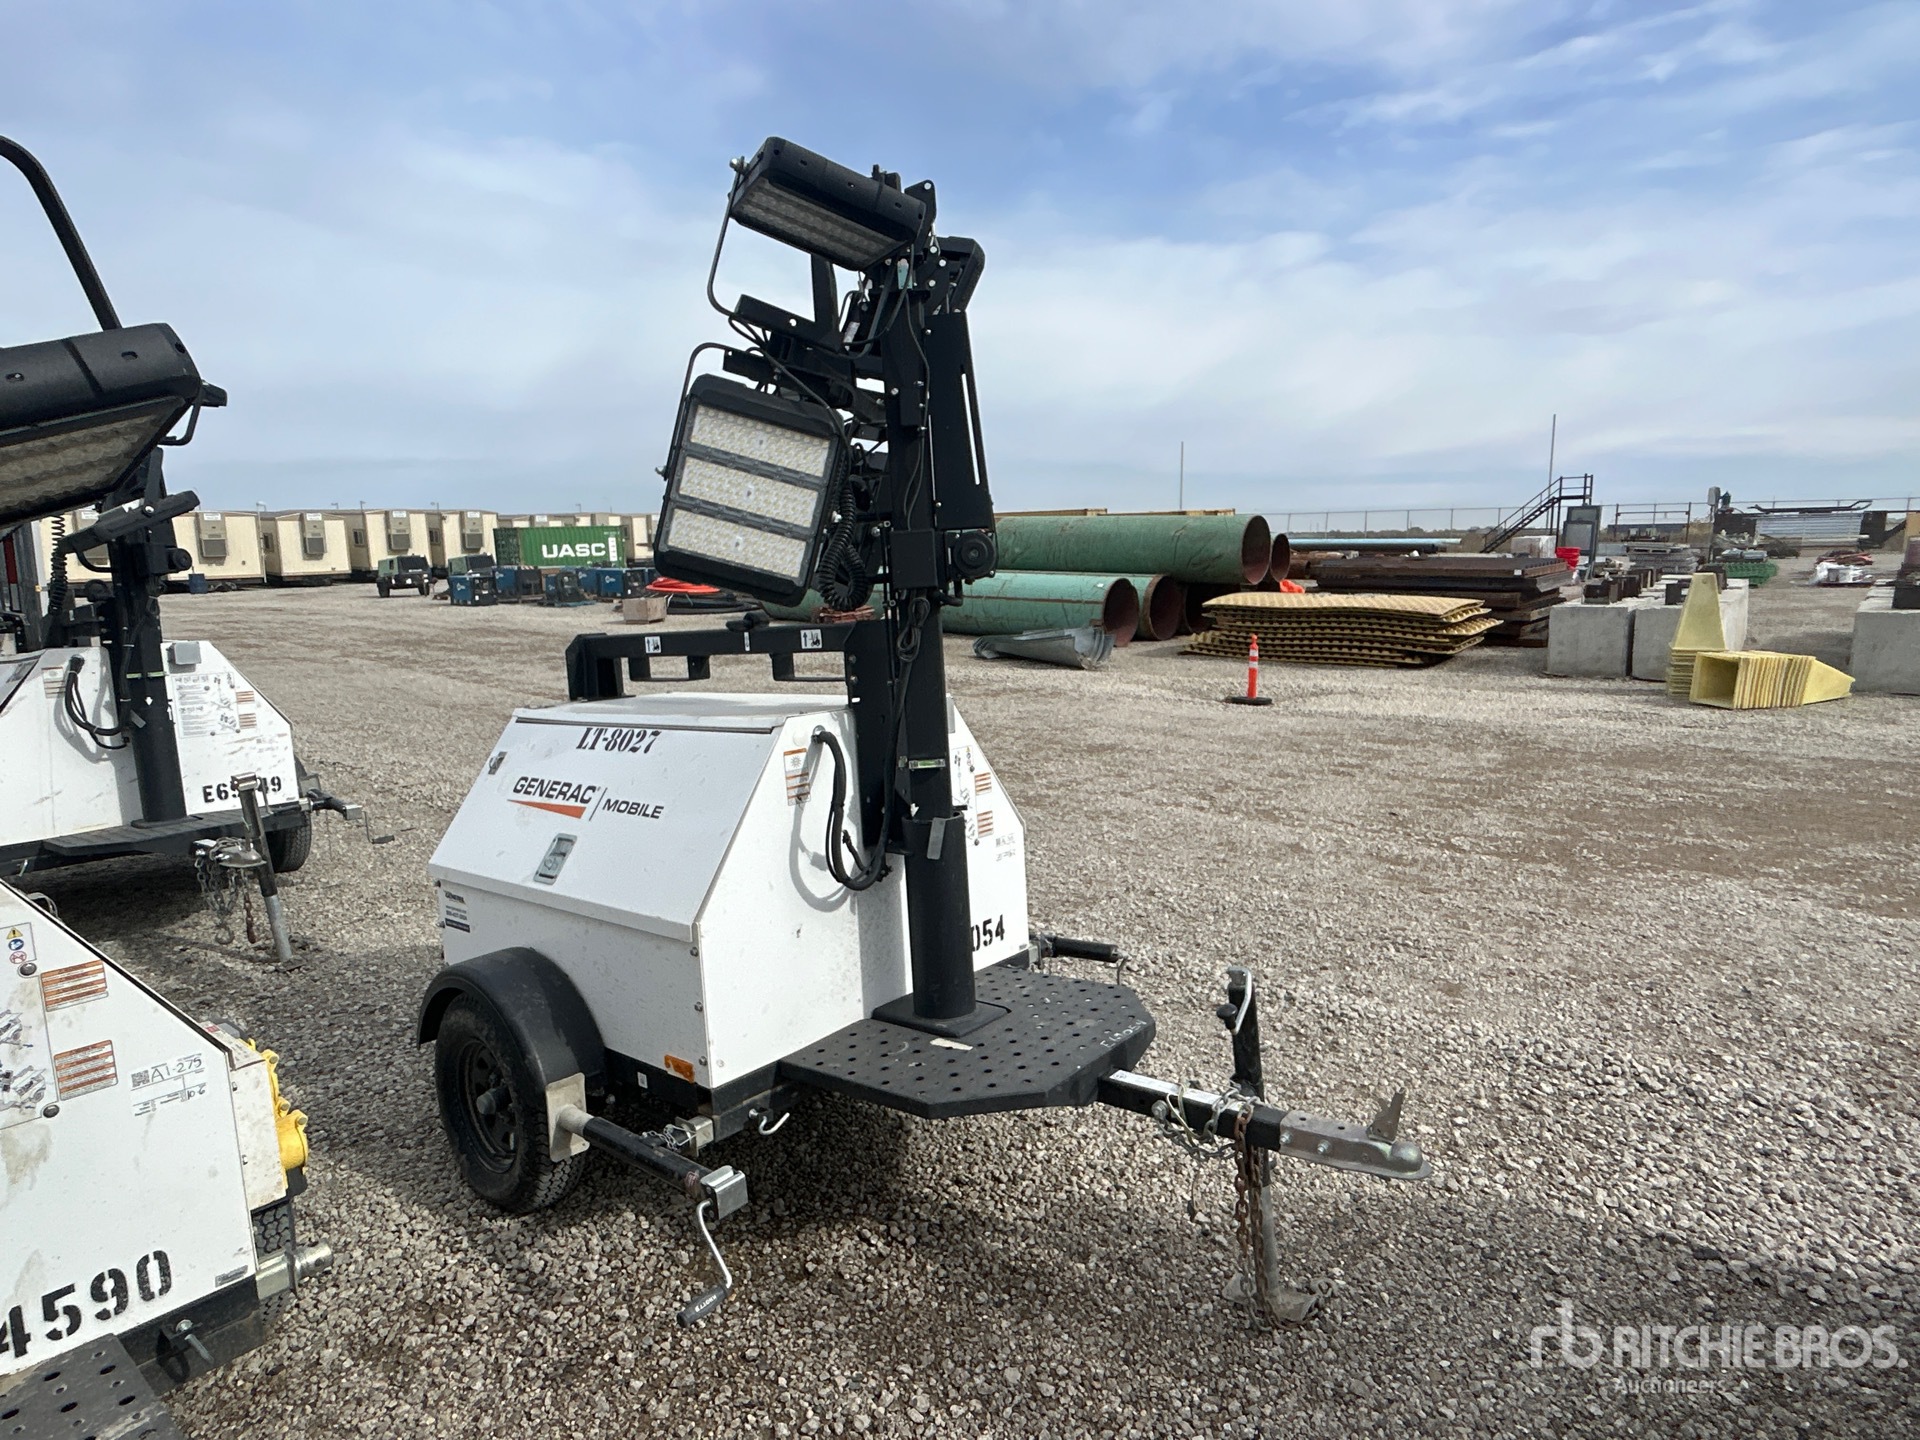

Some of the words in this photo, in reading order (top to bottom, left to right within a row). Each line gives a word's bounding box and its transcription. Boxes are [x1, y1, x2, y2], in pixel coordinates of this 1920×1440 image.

[541, 543, 606, 558] UASC
[576, 727, 661, 754] LT-8027
[513, 776, 597, 804] GENERAC
[602, 798, 664, 819] MOBILE
[0, 1250, 172, 1358] 4590
